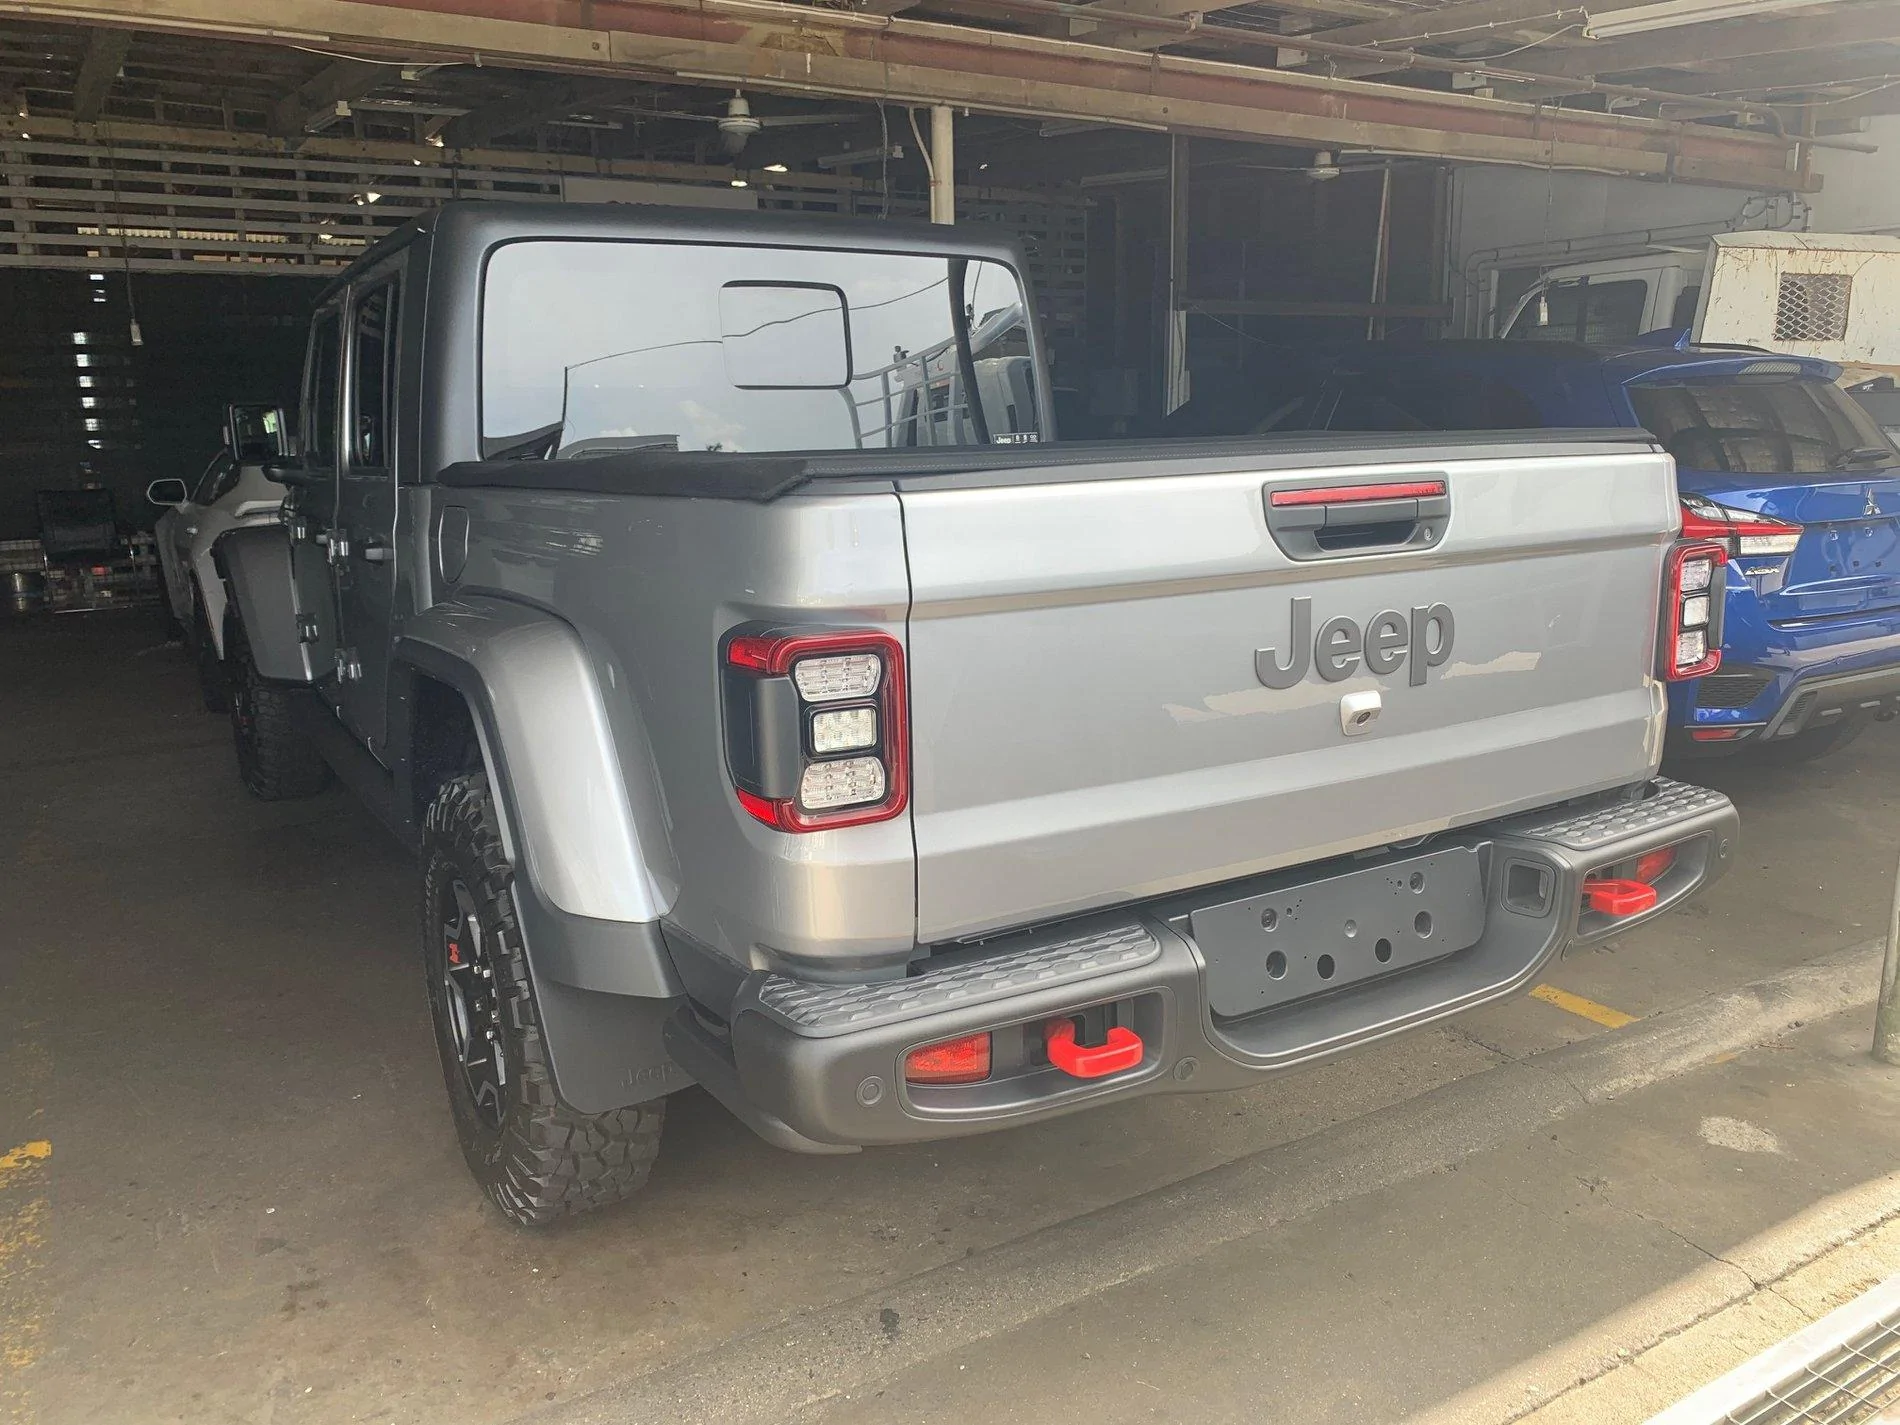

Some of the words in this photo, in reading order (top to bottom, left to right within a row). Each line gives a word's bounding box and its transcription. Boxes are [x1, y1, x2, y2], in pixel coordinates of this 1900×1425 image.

[996, 436, 1012, 444] Jeep
[1254, 596, 1455, 690] Jeep
[618, 1062, 673, 1089] Jeep
